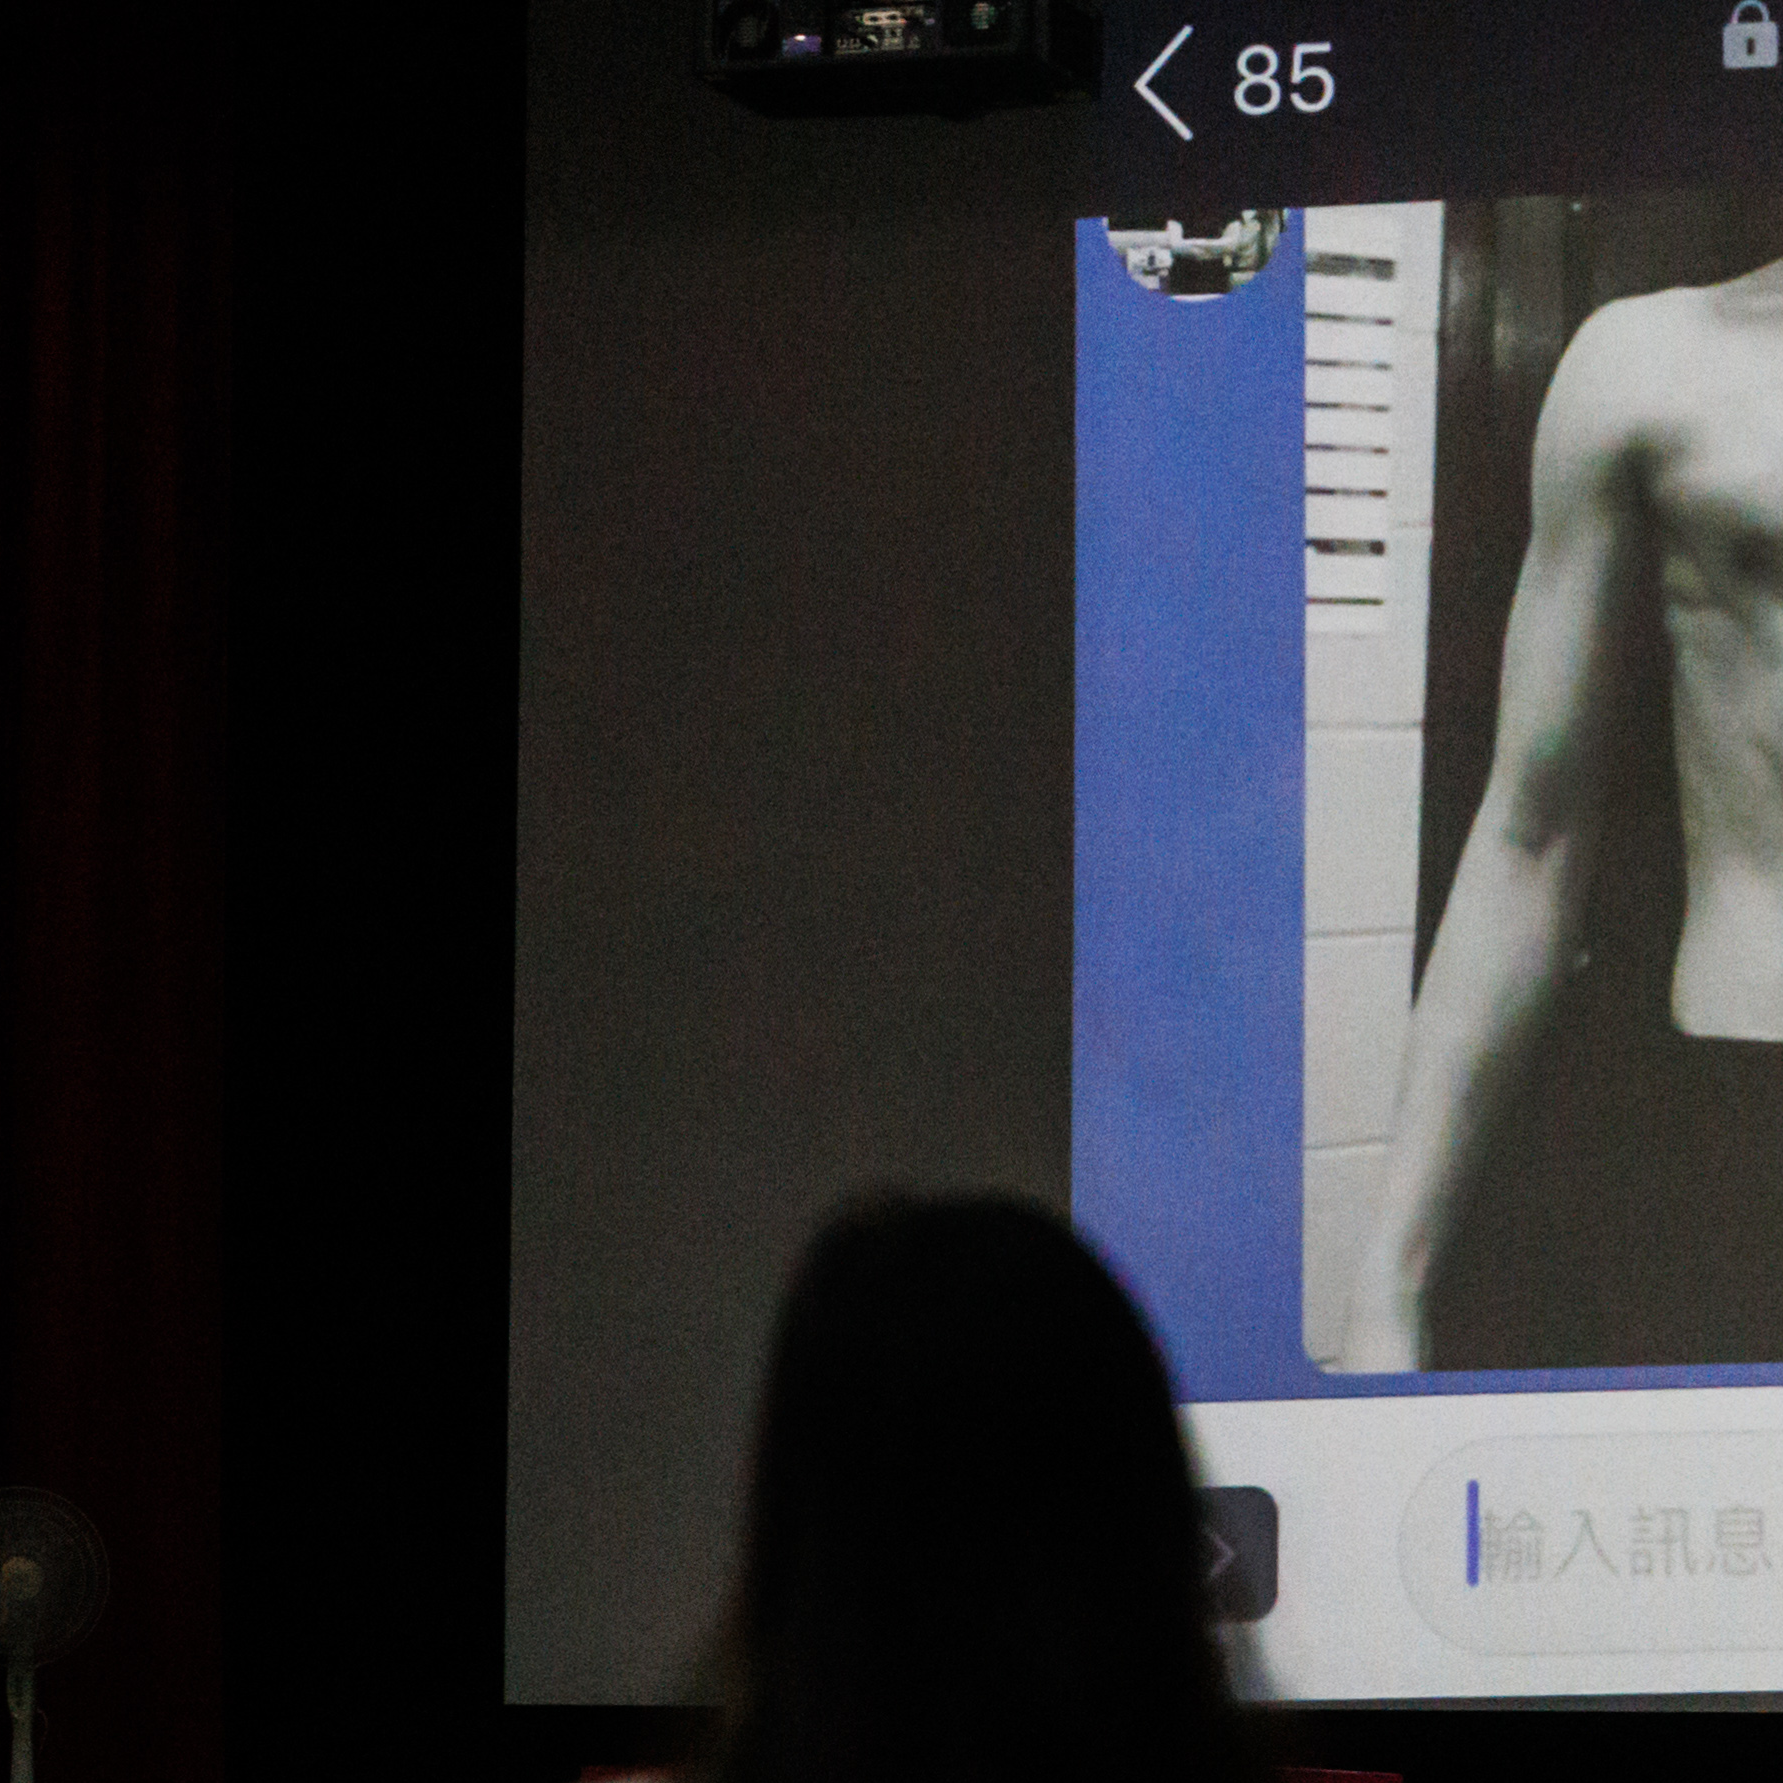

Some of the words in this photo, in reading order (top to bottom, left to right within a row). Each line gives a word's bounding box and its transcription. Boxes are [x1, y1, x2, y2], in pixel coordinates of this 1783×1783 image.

[1233, 41, 1336, 116] 85
[1481, 1504, 1773, 1583] 輸入訊息
